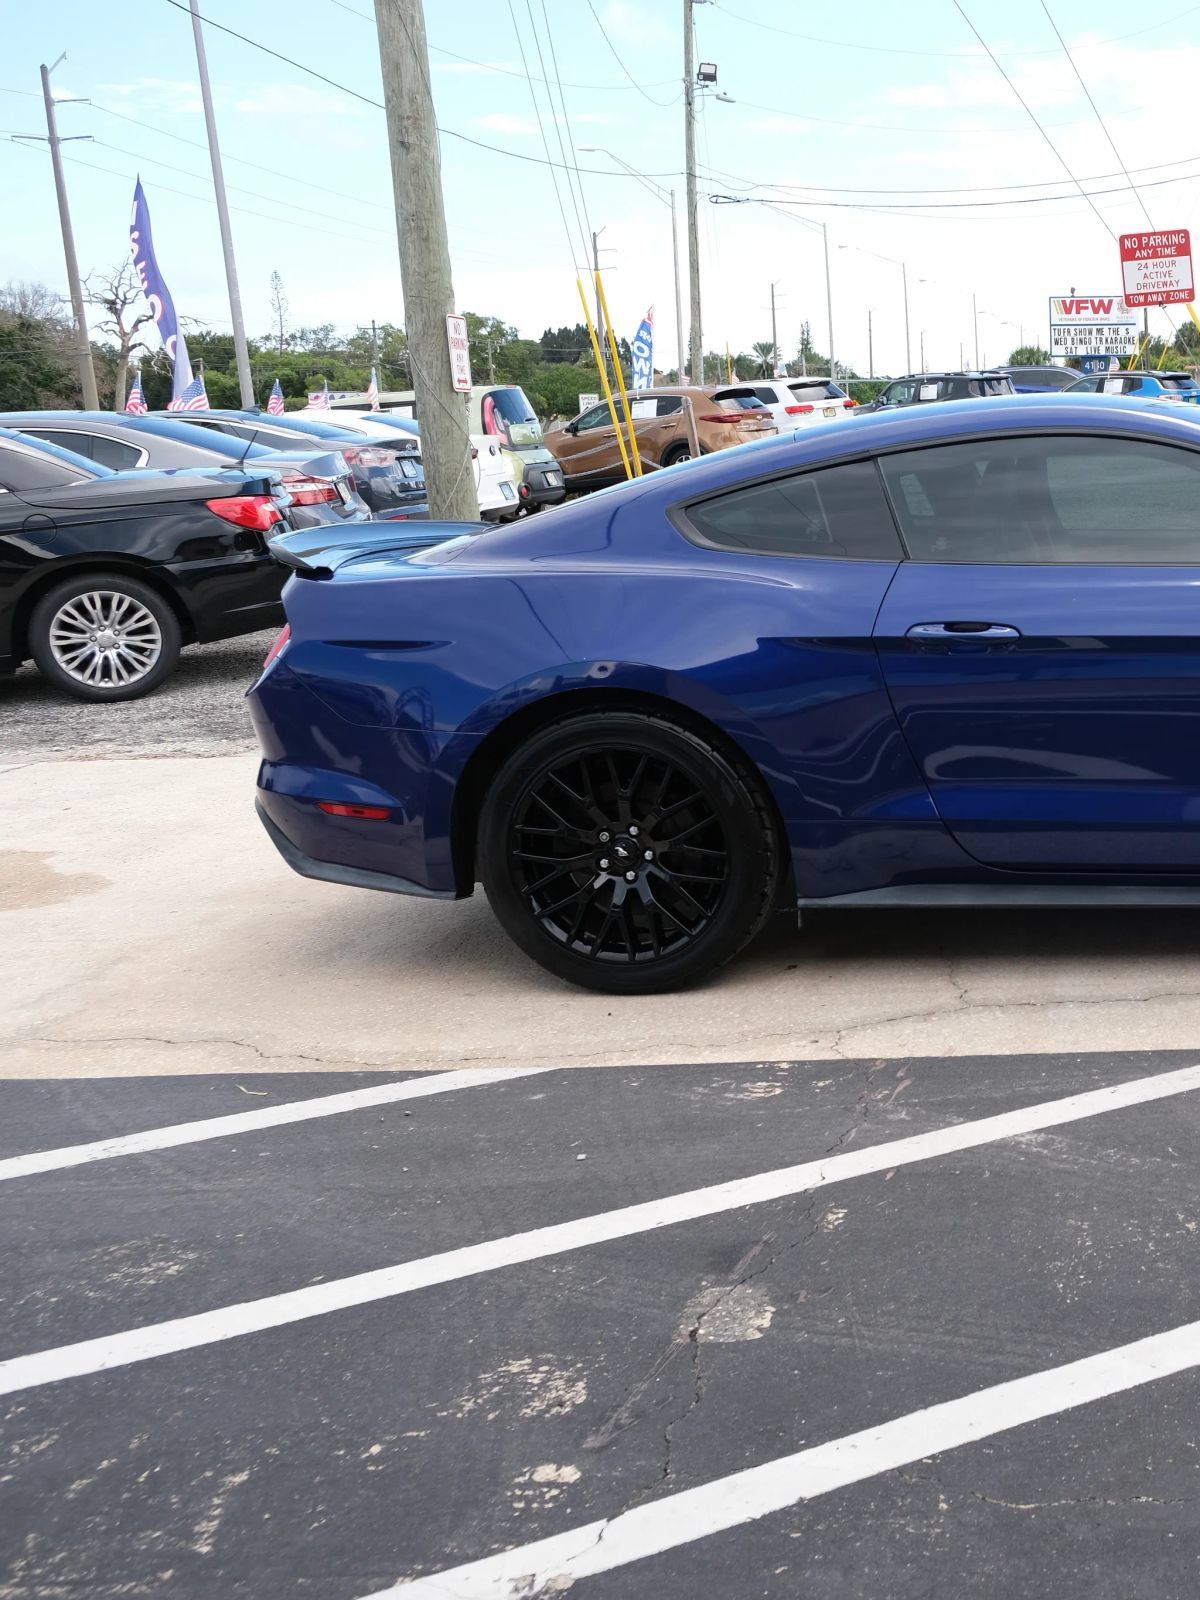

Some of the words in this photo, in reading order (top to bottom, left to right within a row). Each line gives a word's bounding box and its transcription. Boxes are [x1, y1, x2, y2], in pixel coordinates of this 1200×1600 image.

[1124, 238, 1138, 249] NO
[1142, 233, 1186, 247] PARKING
[1135, 248, 1153, 258] ANY
[1157, 246, 1177, 256] TIME
[1137, 262, 1149, 271] 24
[1152, 259, 1177, 269] HOUR
[1143, 270, 1174, 280] ACTIVE
[1136, 279, 1180, 291] DRIVEWAY
[1129, 295, 1144, 304] TOW
[1147, 292, 1167, 302] AWAY
[1169, 290, 1190, 301] ZONE
[1061, 299, 1114, 314] VFW
[1074, 327, 1093, 336] SHOW
[1096, 327, 1105, 336] ME
[1108, 327, 1120, 335] THE
[1054, 337, 1068, 346] WED
[1071, 337, 1092, 345] BINGO
[1105, 336, 1136, 345] KARAOKE
[1064, 346, 1078, 355] SAT
[1086, 346, 1101, 354] LIVE
[1105, 346, 1127, 354] MUSIC
